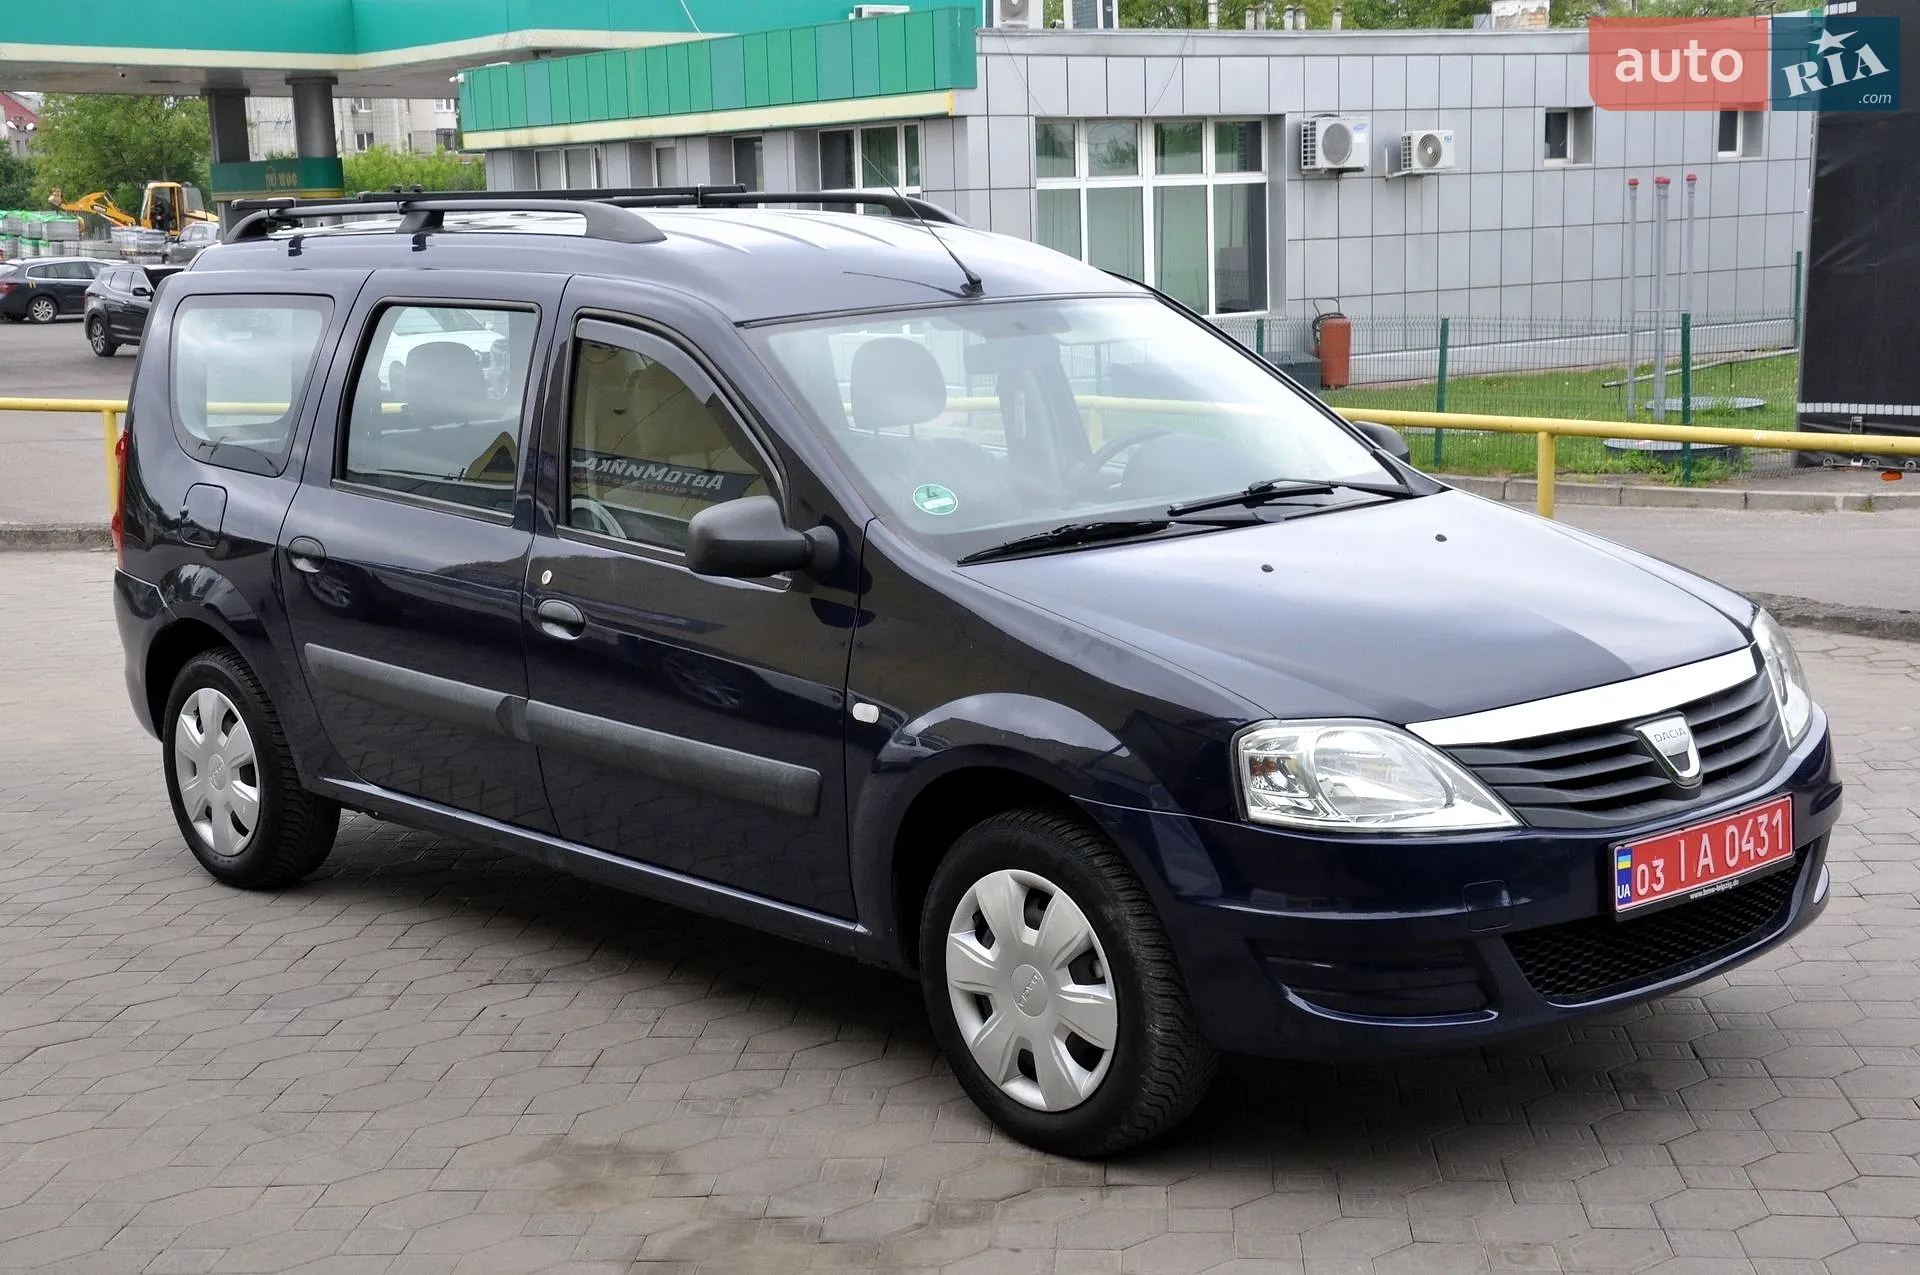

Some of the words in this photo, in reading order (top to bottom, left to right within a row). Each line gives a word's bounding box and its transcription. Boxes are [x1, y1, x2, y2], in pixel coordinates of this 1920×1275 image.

[1653, 727, 1687, 743] DACIA
[1636, 857, 1665, 896] 03
[1724, 808, 1783, 868] 0431
[1617, 883, 1631, 899] UA
